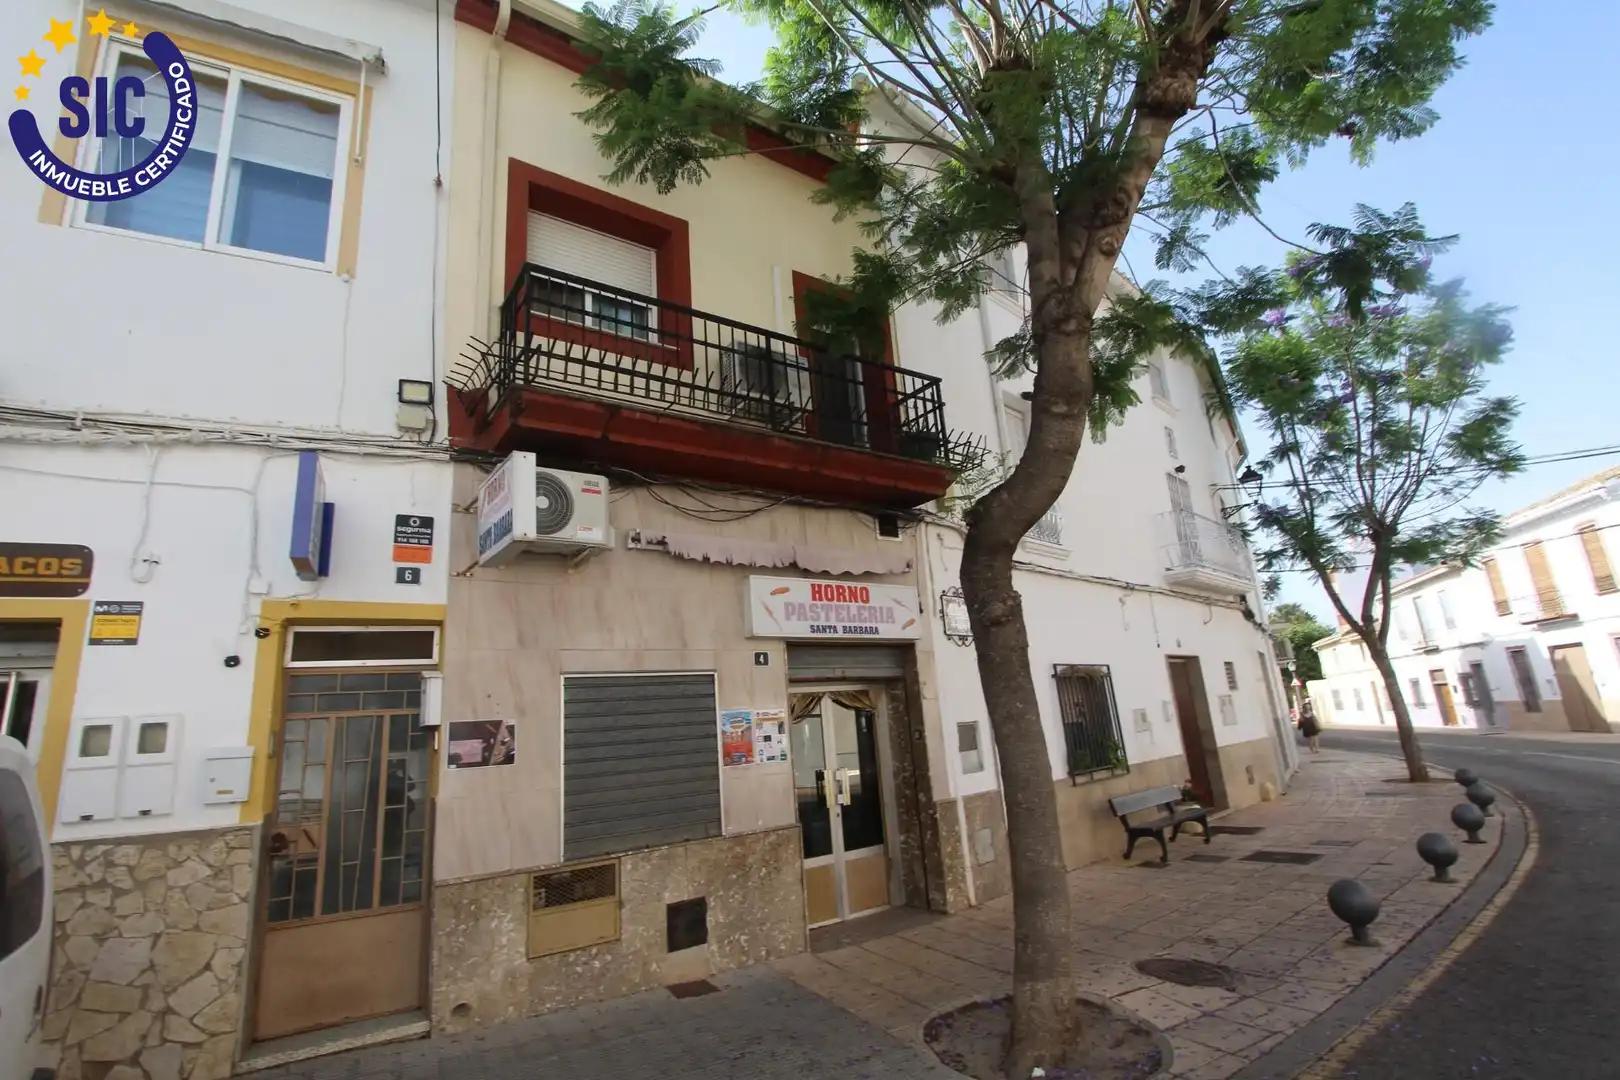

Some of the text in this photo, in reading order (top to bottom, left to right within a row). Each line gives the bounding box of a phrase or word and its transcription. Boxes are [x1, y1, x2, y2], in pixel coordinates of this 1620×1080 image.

[404, 569, 413, 582] 6
[810, 583, 871, 604] HORNO
[784, 602, 896, 624] PASTELERIA
[809, 624, 880, 636] SANTA BARBARA
[758, 654, 765, 665] 4
